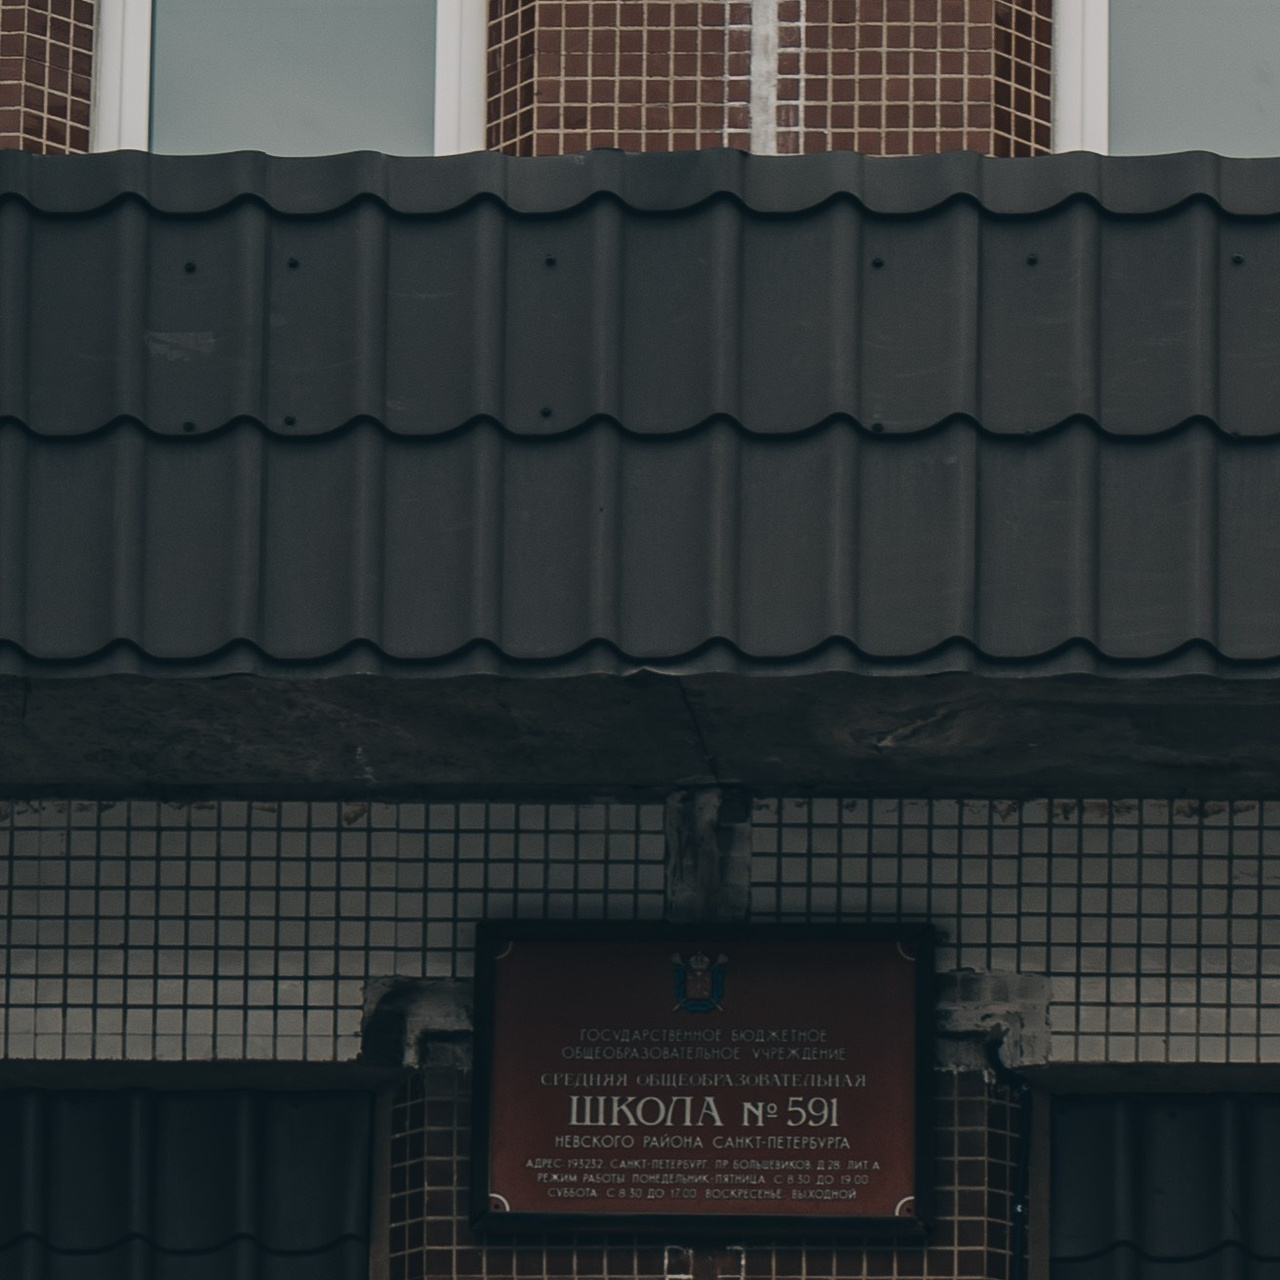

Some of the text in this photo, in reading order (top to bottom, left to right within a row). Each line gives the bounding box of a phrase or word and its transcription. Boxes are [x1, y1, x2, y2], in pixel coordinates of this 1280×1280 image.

[579, 1028, 827, 1044] ГОСУДАРСТВЕННОЕ БЮДЖЕТНОЕ
[561, 1045, 847, 1062] ОБЩЕОБРАЗОВАТЕЛЬНОЕ УЧРЕЖДЕНИЕ
[541, 1072, 867, 1088] СРЕДНЯЯ ОБЩЕОБРАЗОВАТЕЛЬНАЯ
[568, 1095, 840, 1128] ШКОЛА № 591
[555, 1134, 851, 1150] НЕВСКОГО РАЙОНА САНКТ-ПЕТЕРБУРГА
